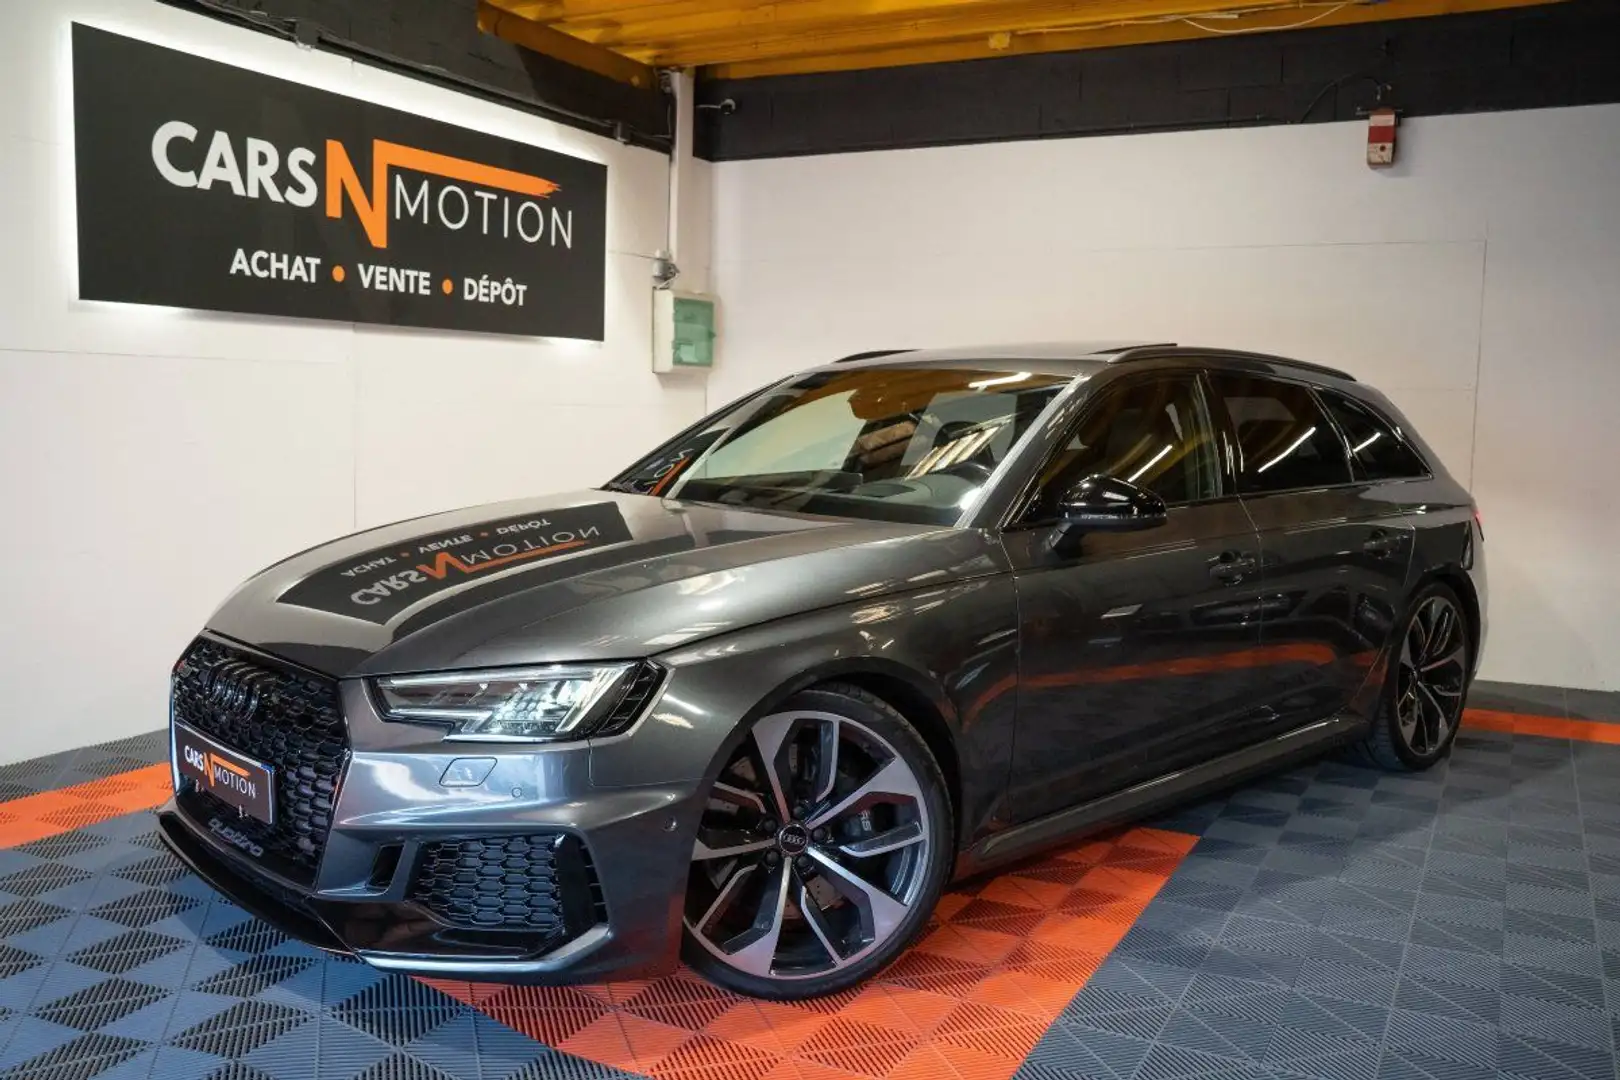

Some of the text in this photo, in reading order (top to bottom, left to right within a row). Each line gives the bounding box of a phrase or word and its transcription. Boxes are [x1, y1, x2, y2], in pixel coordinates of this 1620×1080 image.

[151, 120, 319, 207] CARS
[395, 173, 573, 249] MOTION
[229, 248, 528, 307] ACHAT VENTE DÉPÔT
[184, 745, 204, 771] CARS
[215, 765, 256, 799] MOTION
